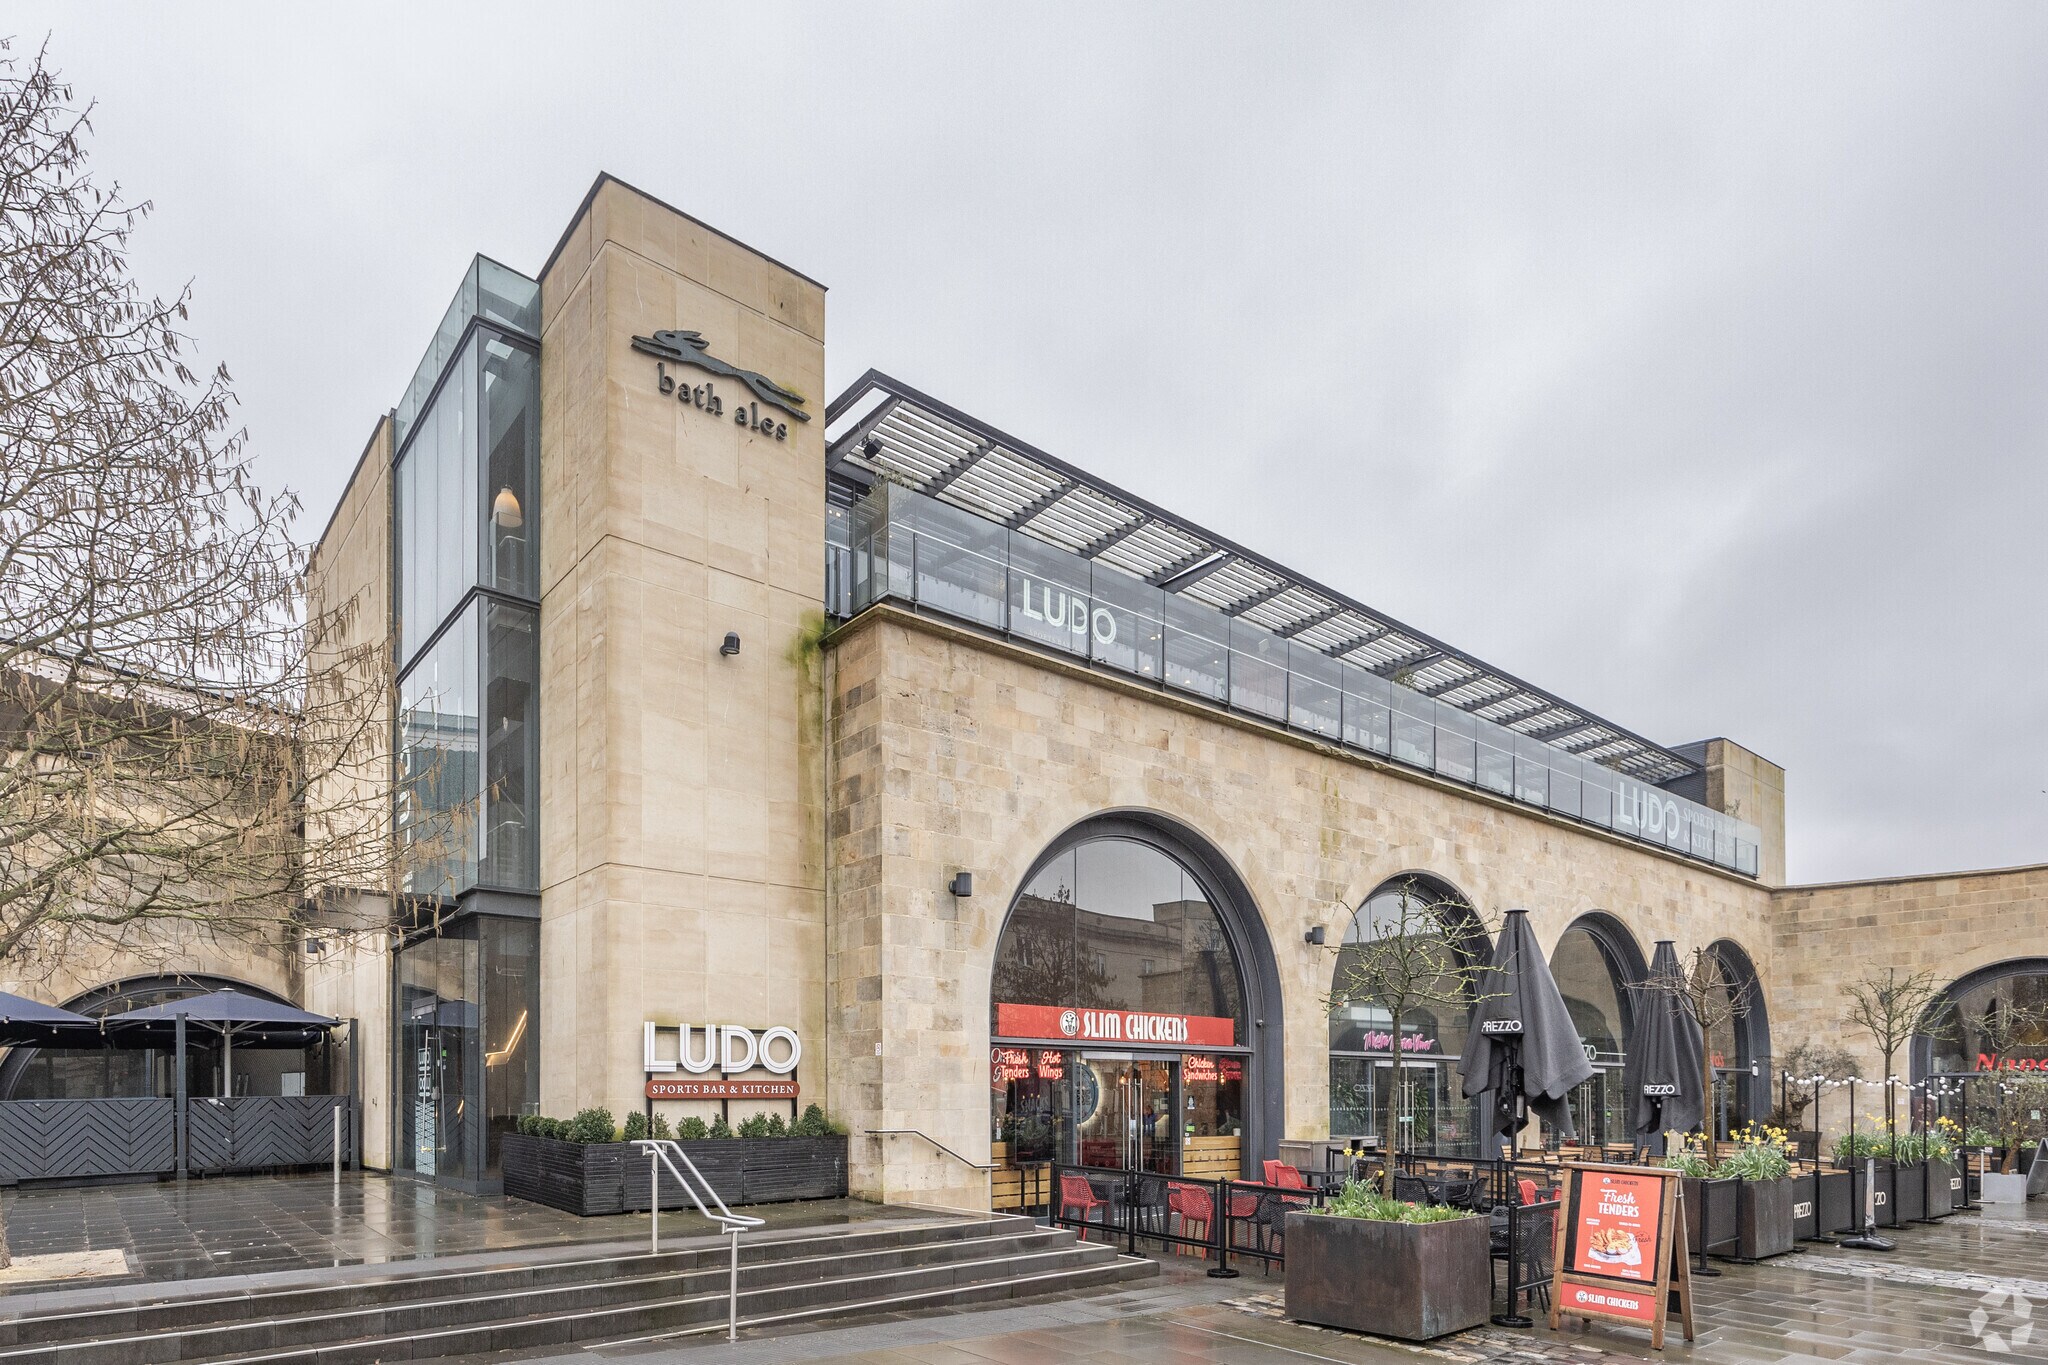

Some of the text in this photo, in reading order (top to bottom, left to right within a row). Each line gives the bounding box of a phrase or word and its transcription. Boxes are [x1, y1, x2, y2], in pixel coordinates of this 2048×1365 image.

[657, 362, 788, 441] bath ales
[1023, 578, 1117, 645] LUDO
[1619, 781, 1680, 840] LUDO
[1083, 1011, 1188, 1042] SLIM CHICKENS
[644, 1021, 802, 1074] LUDO
[1041, 1051, 1062, 1065] Hot
[1188, 1056, 1215, 1069] Chicken
[1001, 1065, 1063, 1079] Tenders Wings
[1183, 1068, 1218, 1080] Sandwiches
[652, 1084, 795, 1094] SPORTS BAR & KITCHEN
[1600, 1188, 1636, 1204] Fresh
[1598, 1202, 1640, 1218] TENDERS
[1793, 1201, 1812, 1219] PREZZO
[1588, 1293, 1639, 1310] SLIM CHICKENS
